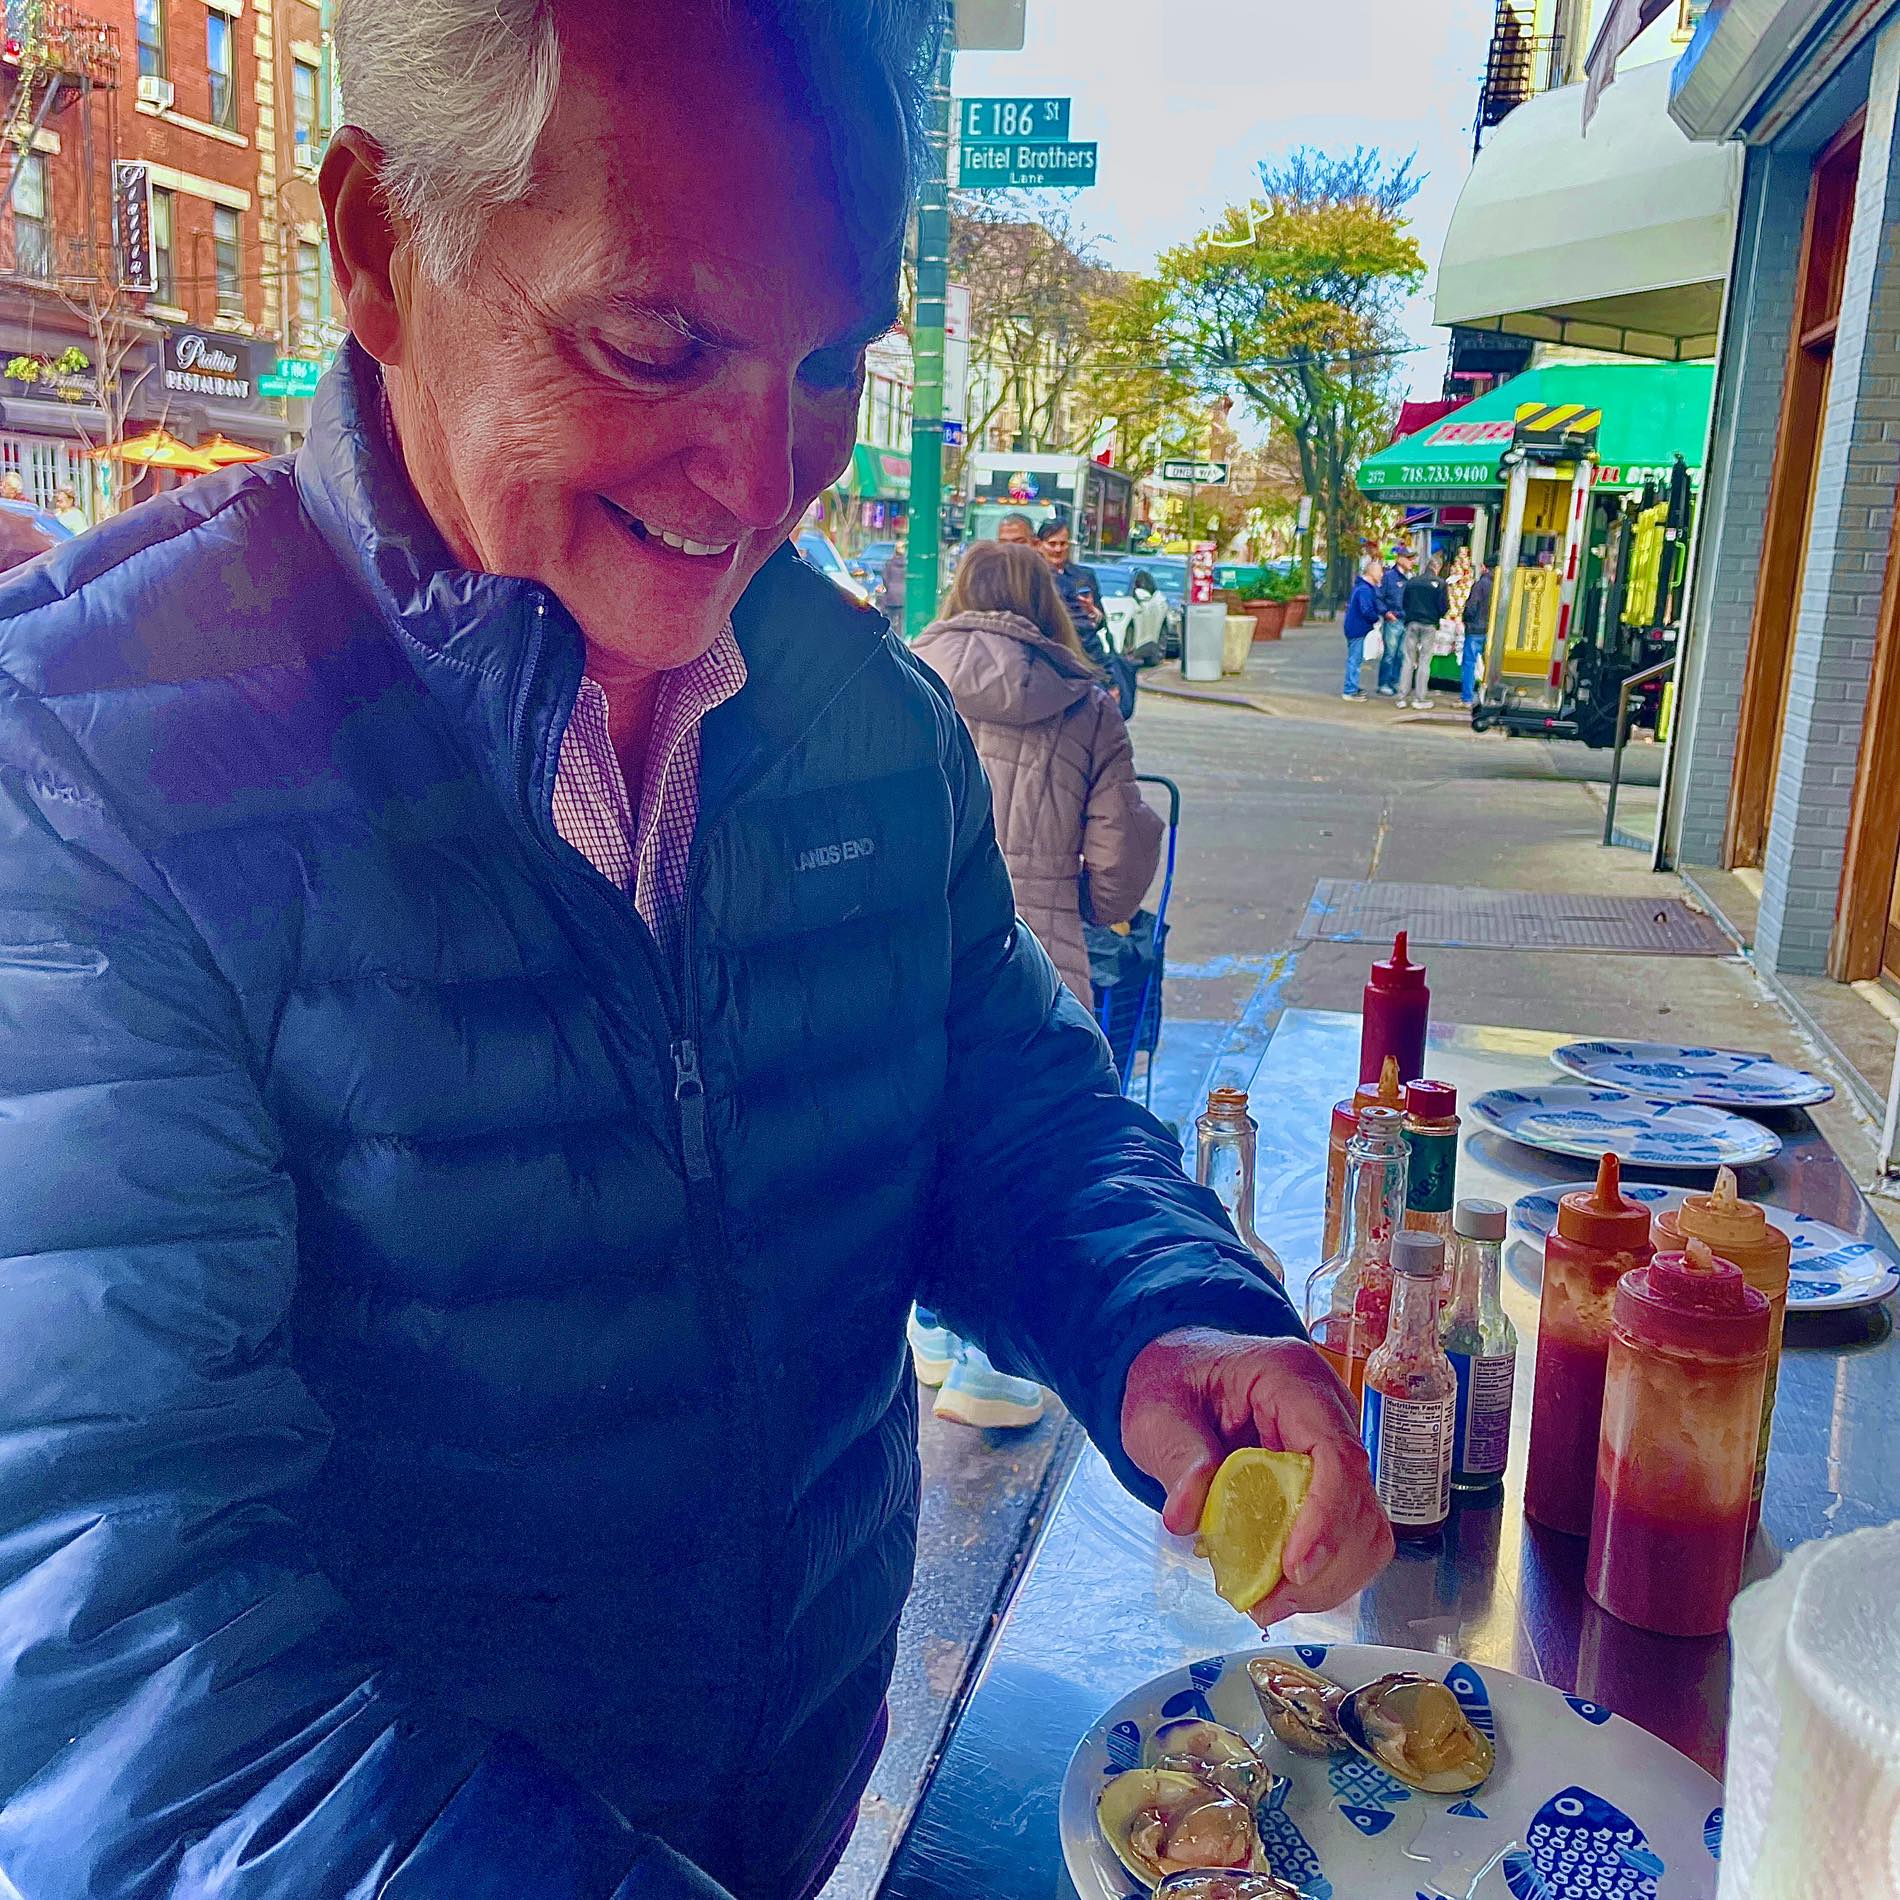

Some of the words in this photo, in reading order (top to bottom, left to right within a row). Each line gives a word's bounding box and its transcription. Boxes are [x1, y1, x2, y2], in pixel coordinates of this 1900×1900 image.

[968, 103, 982, 135] E
[993, 103, 1034, 135] 186
[1043, 102, 1060, 121] St
[964, 146, 1010, 169] Teitel
[1017, 146, 1094, 168] Brothers
[1010, 172, 1045, 184] Lane
[166, 369, 250, 398] RESTAURANT
[1401, 465, 1488, 482] 718.733.9400
